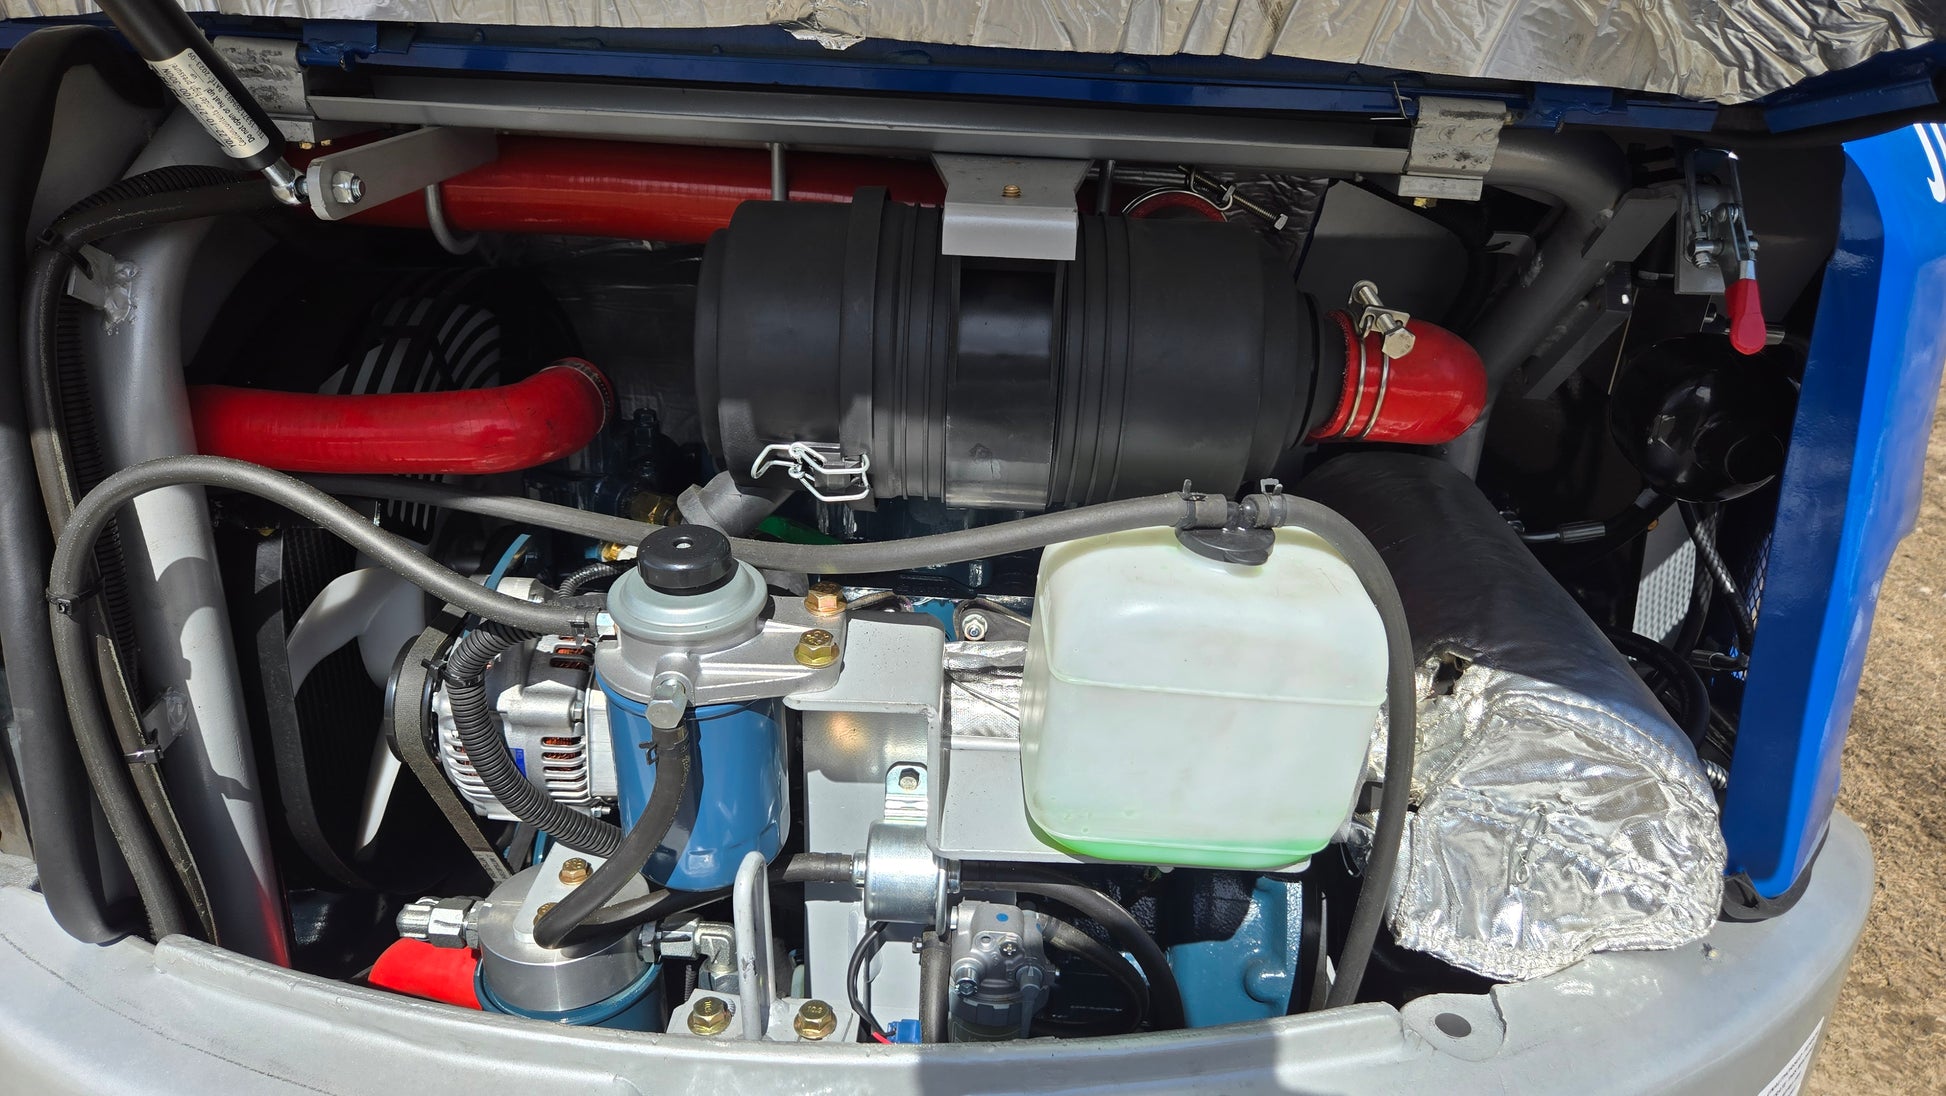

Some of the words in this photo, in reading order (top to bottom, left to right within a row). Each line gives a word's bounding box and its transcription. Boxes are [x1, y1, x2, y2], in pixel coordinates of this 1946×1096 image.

[203, 84, 217, 98] up!
[211, 94, 225, 110] heat
[222, 105, 231, 114] or
[228, 111, 243, 126] open
[237, 124, 249, 136] not
[244, 132, 255, 143] Do
